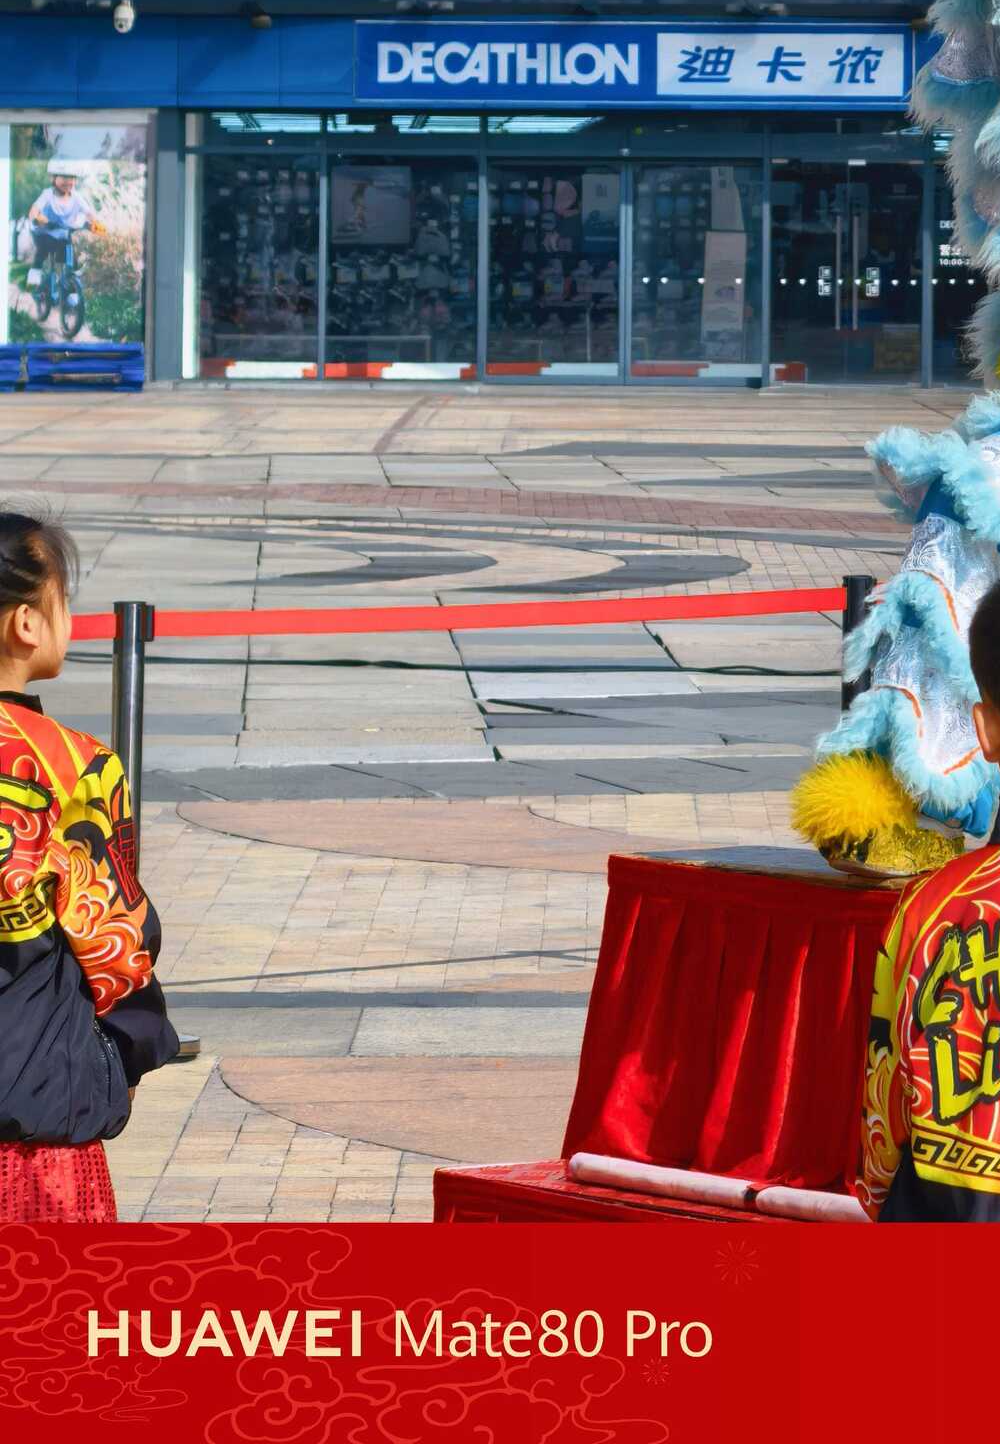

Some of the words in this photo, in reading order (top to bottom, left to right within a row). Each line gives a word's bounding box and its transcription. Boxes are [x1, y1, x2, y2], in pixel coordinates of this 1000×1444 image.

[377, 42, 639, 85] DECATHLON
[677, 46, 884, 84] 迪卡侬
